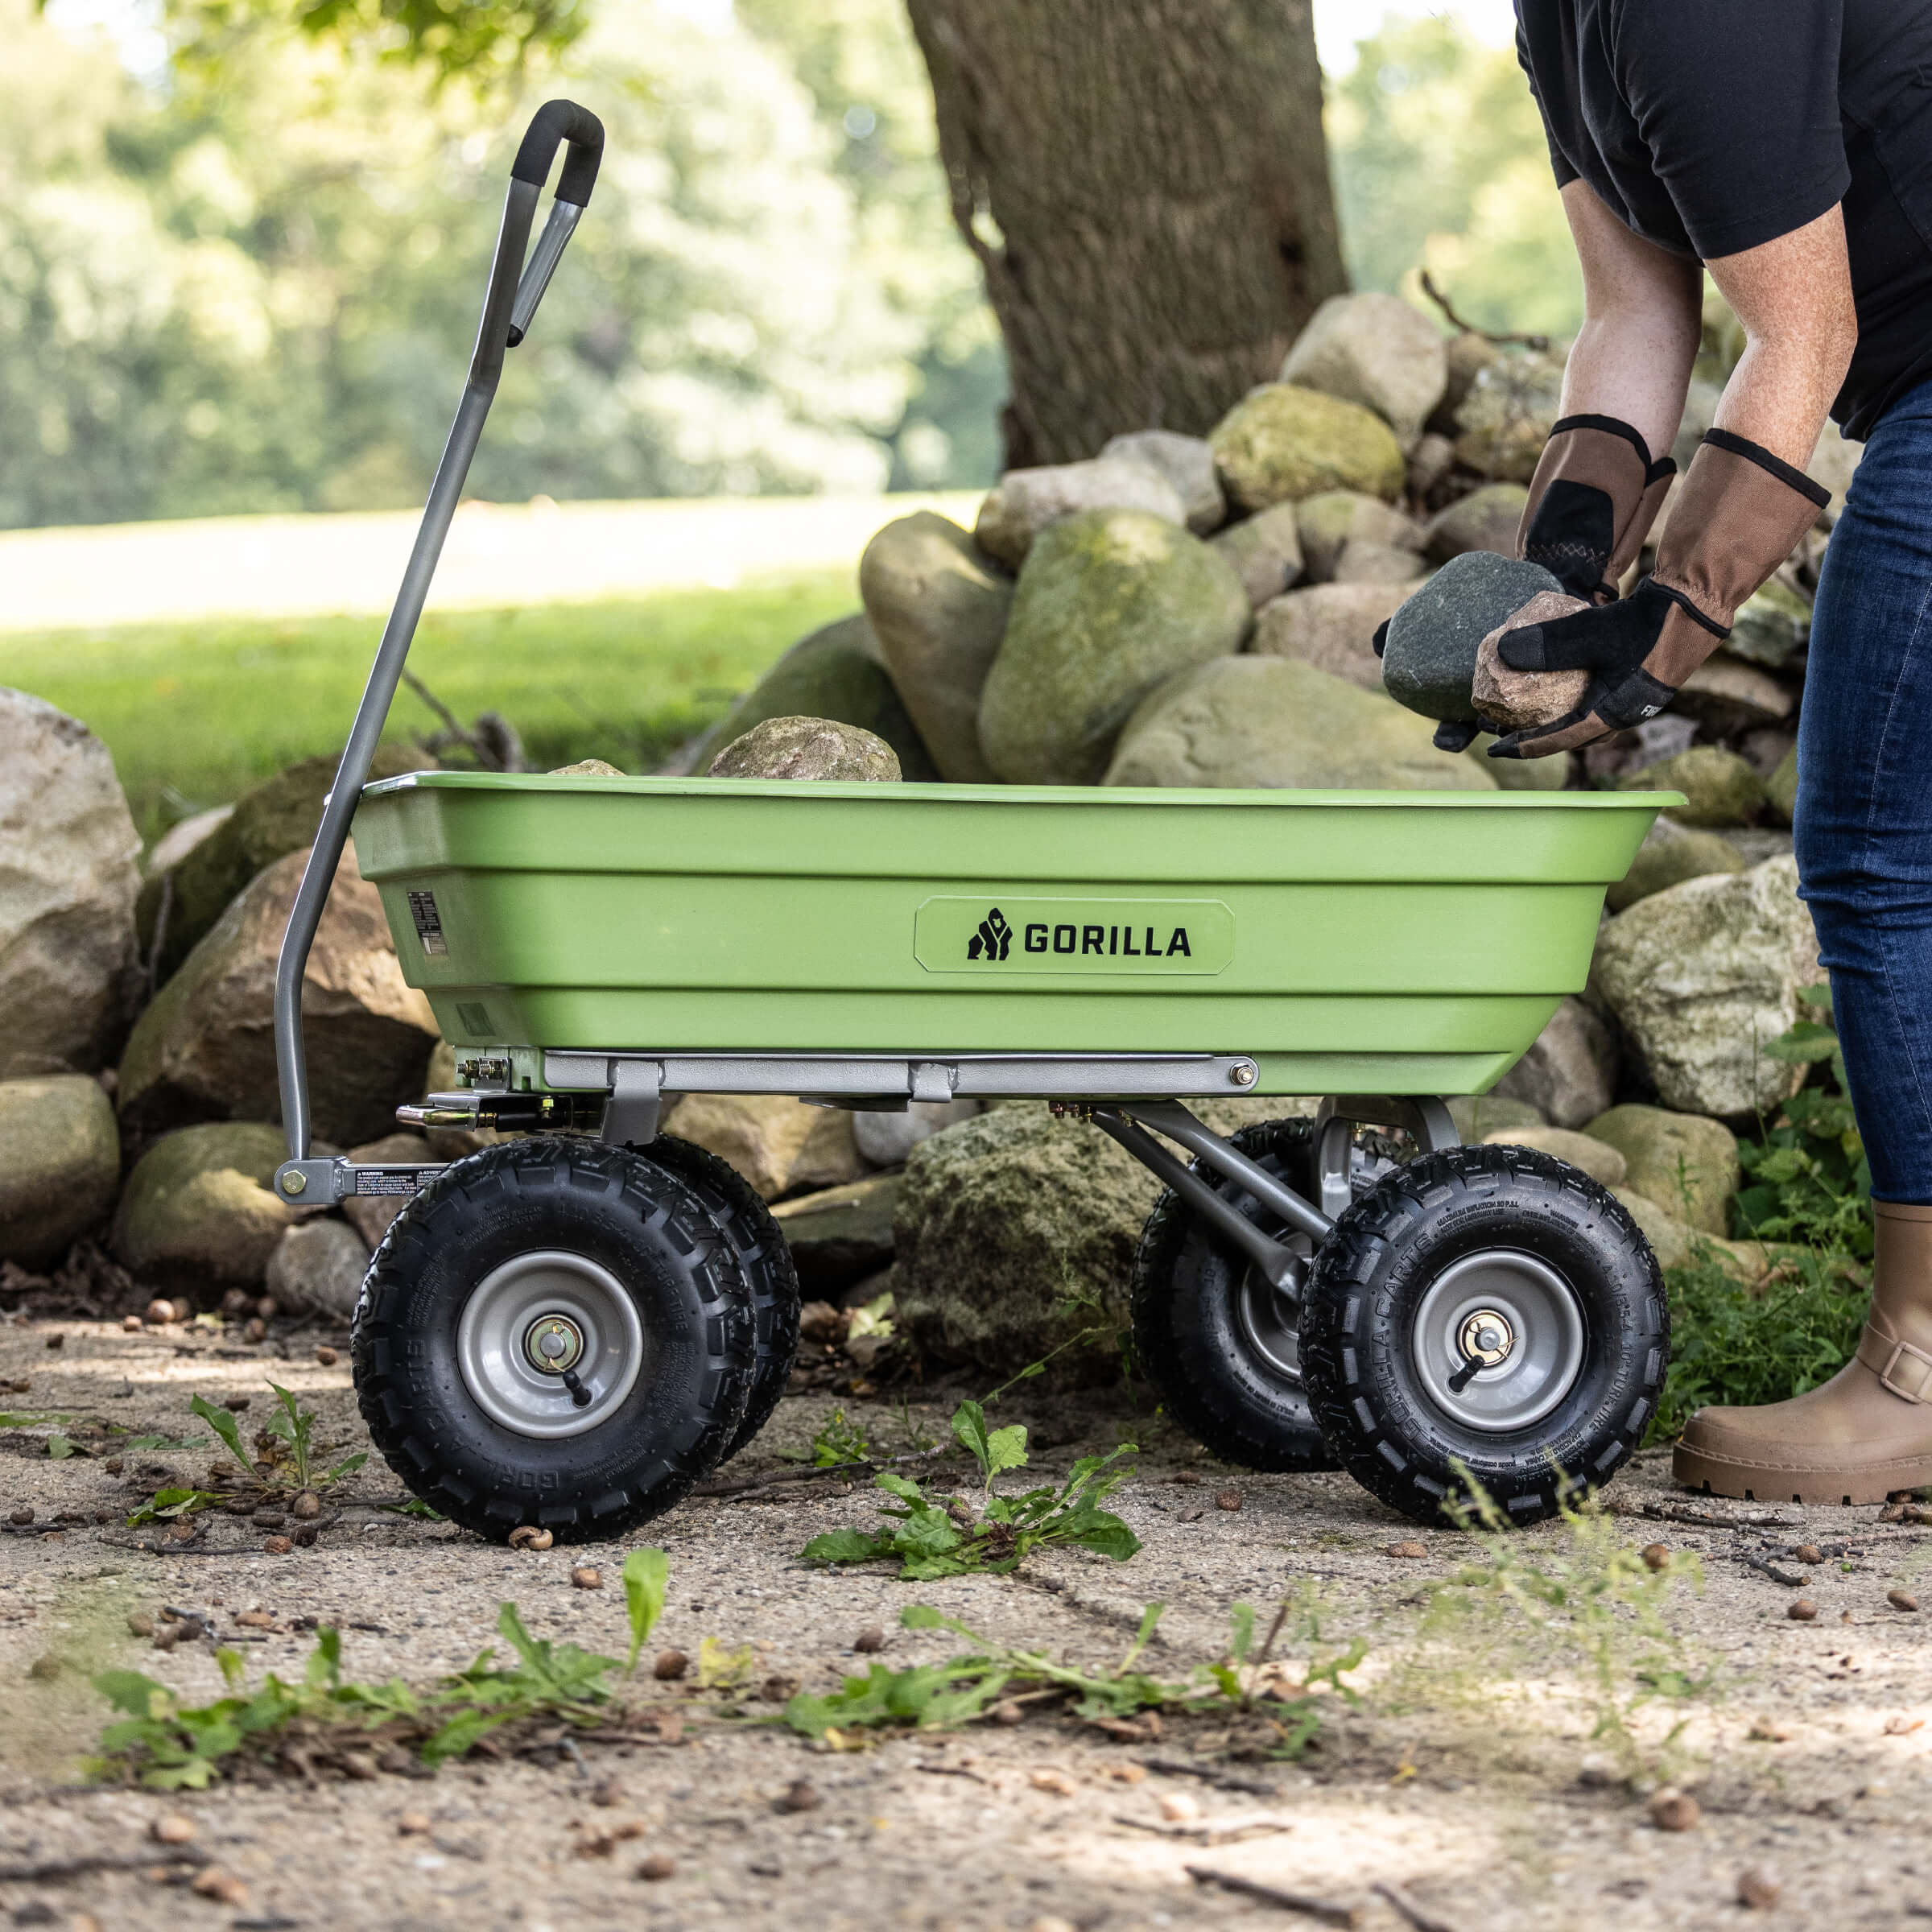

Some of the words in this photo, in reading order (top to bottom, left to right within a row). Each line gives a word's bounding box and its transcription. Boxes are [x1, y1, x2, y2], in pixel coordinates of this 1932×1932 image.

[1024, 923, 1191, 957] GORILLA
[1375, 1232, 1435, 1319] CARTS
[1372, 1328, 1420, 1441] GORILLA
